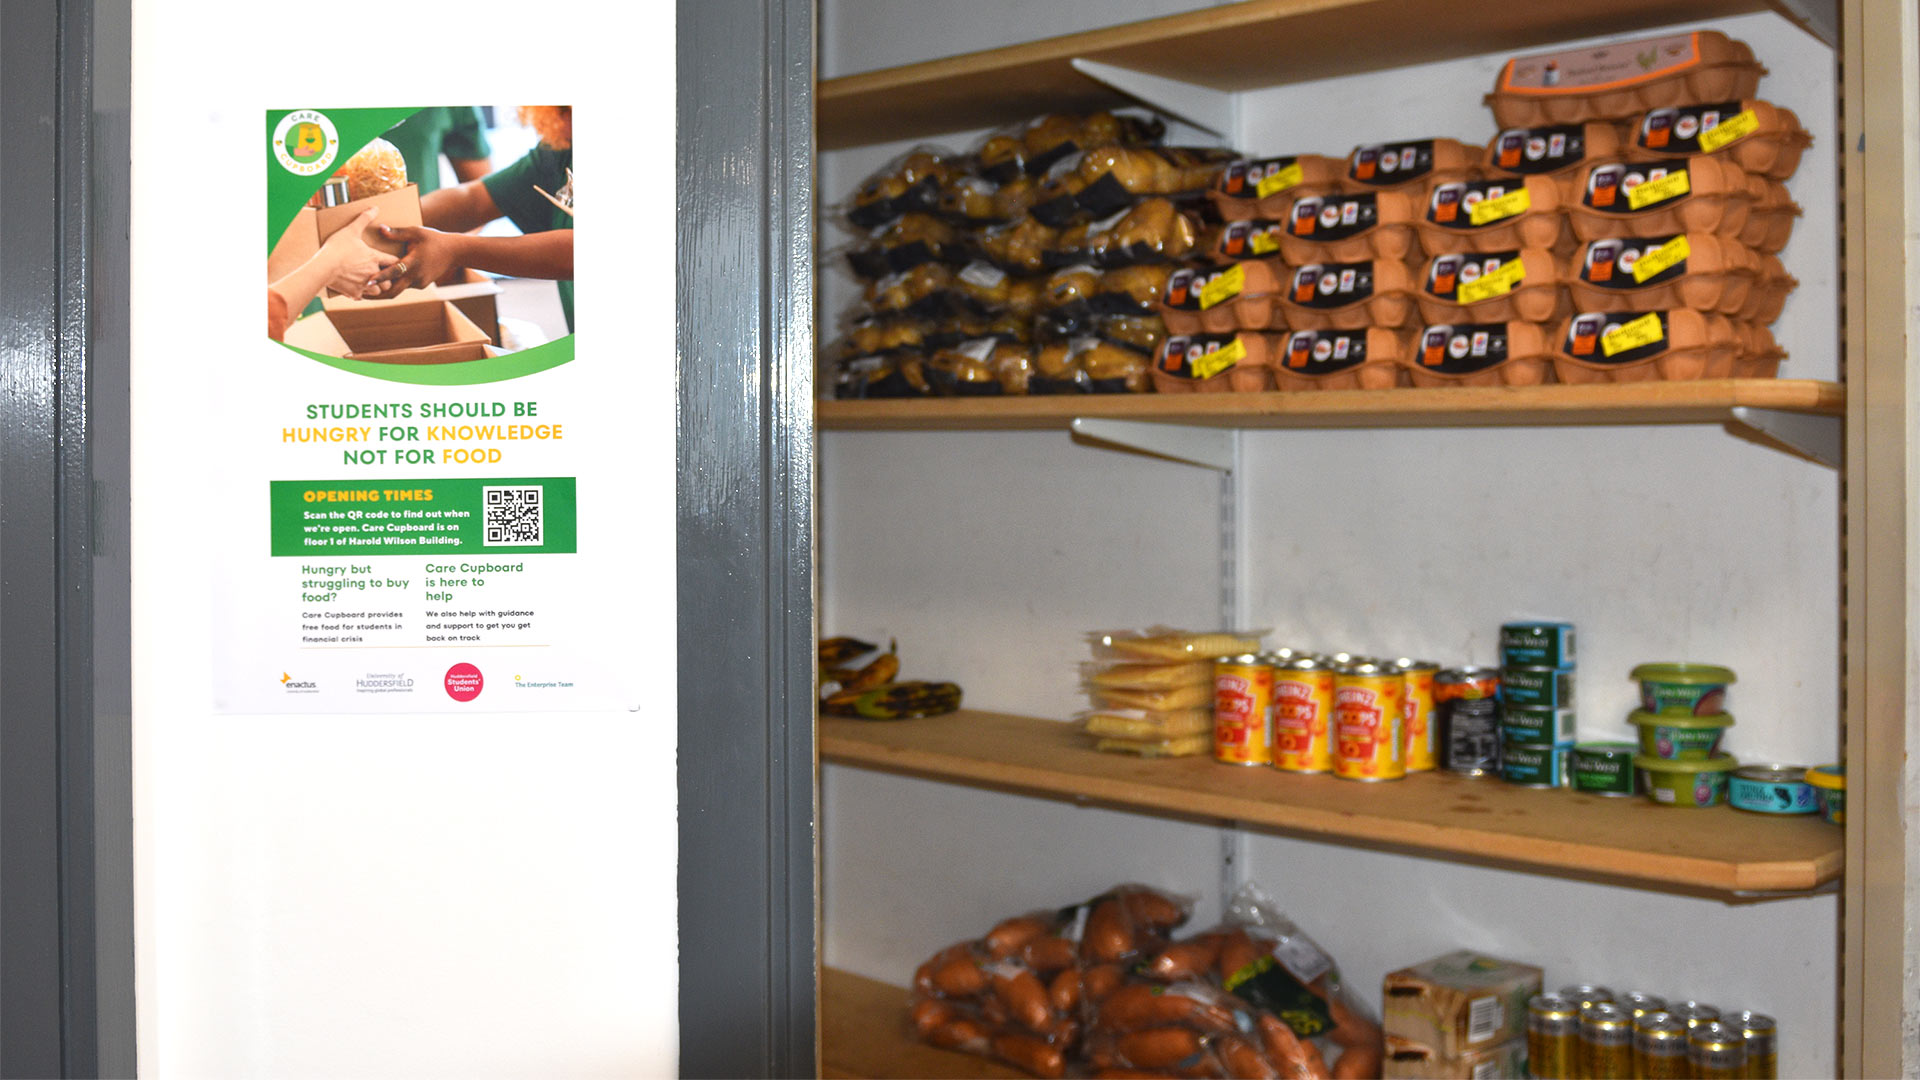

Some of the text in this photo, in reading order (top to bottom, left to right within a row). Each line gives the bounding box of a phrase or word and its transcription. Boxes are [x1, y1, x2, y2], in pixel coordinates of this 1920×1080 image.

[291, 113, 320, 122] CARE
[280, 152, 332, 172] CUPBOARD
[307, 402, 537, 419] STUDENTS SHOULD BE
[283, 425, 562, 442] HUNGRY FOR KNOWLEDGE
[344, 449, 502, 465] NOT FOR FOOD
[304, 489, 433, 502] OPENING TIMES
[304, 511, 327, 519] Scan
[329, 511, 345, 519] the
[347, 511, 363, 520] QR
[404, 510, 423, 518] find
[425, 510, 442, 518] out
[332, 526, 360, 534] open.
[362, 524, 384, 532] Care
[386, 523, 434, 533] Cupboard
[437, 523, 445, 531] is
[336, 537, 346, 545] of
[349, 537, 381, 545] Harold
[419, 536, 462, 546] Building.
[302, 565, 371, 577] Hungry but
[426, 563, 523, 574] Care Cupboard
[302, 578, 409, 590] struggling to buy
[426, 577, 484, 587] is here to
[302, 592, 337, 602] food?
[426, 591, 453, 603] help
[498, 610, 534, 618] guidance
[356, 679, 414, 687] HUDDERSFIELD
[1338, 691, 1373, 706] HEINZ
